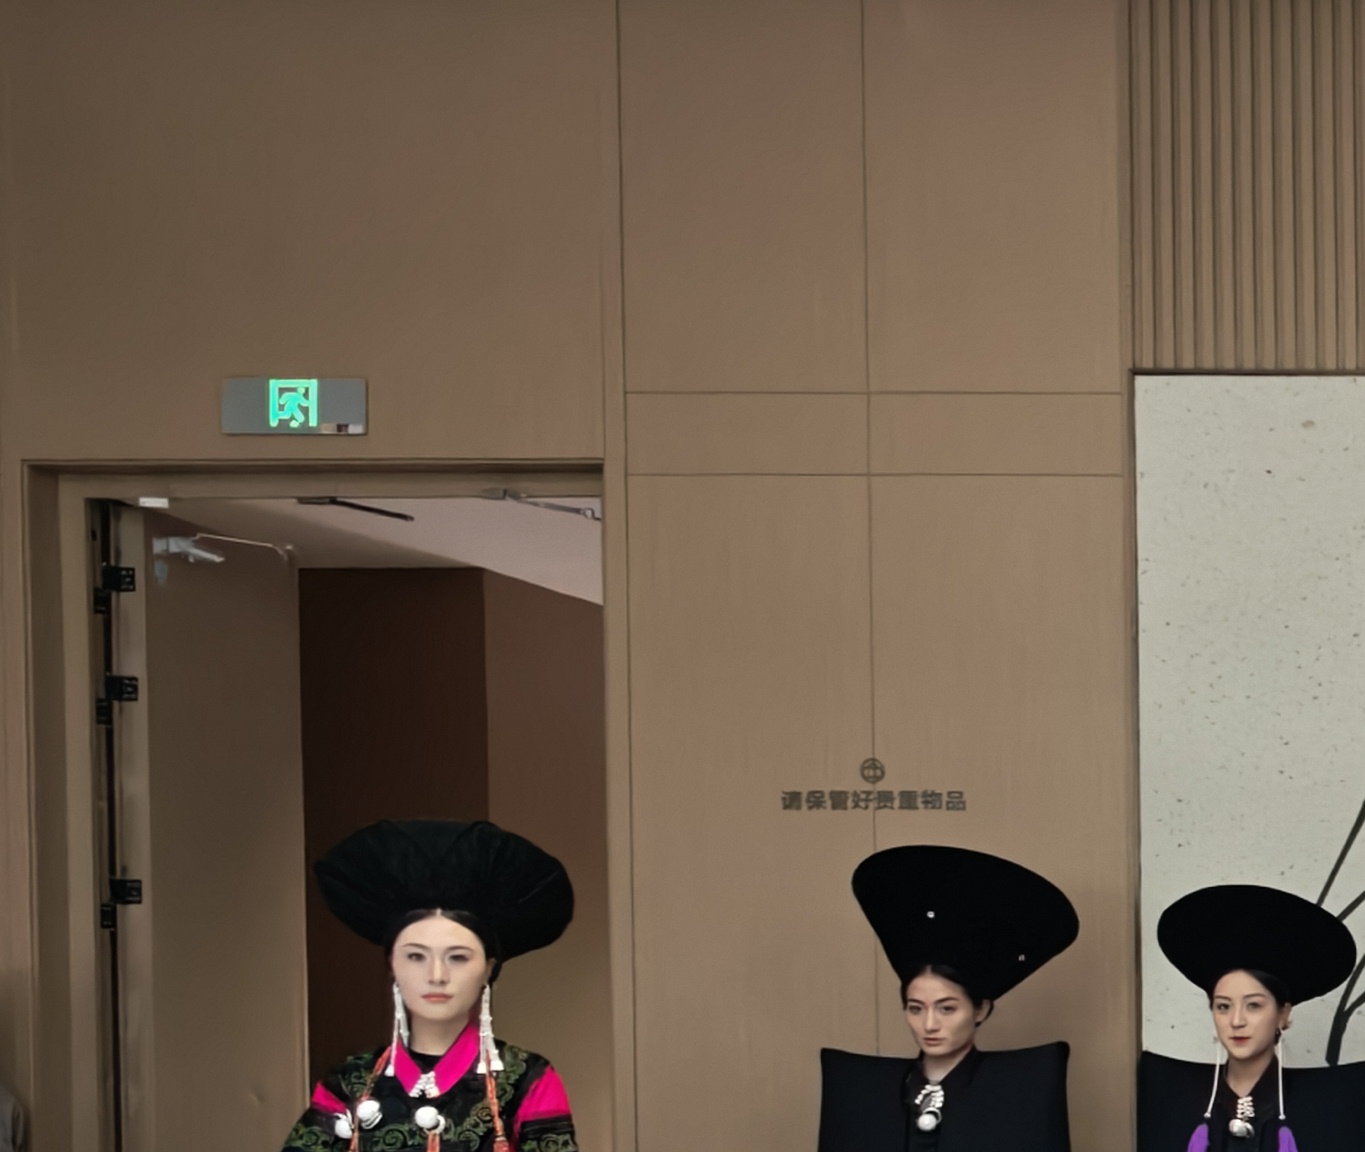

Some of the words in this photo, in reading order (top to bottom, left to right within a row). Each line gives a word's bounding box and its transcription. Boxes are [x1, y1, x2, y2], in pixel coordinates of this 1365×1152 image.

[781, 789, 966, 812] 请保管好贵重物品
